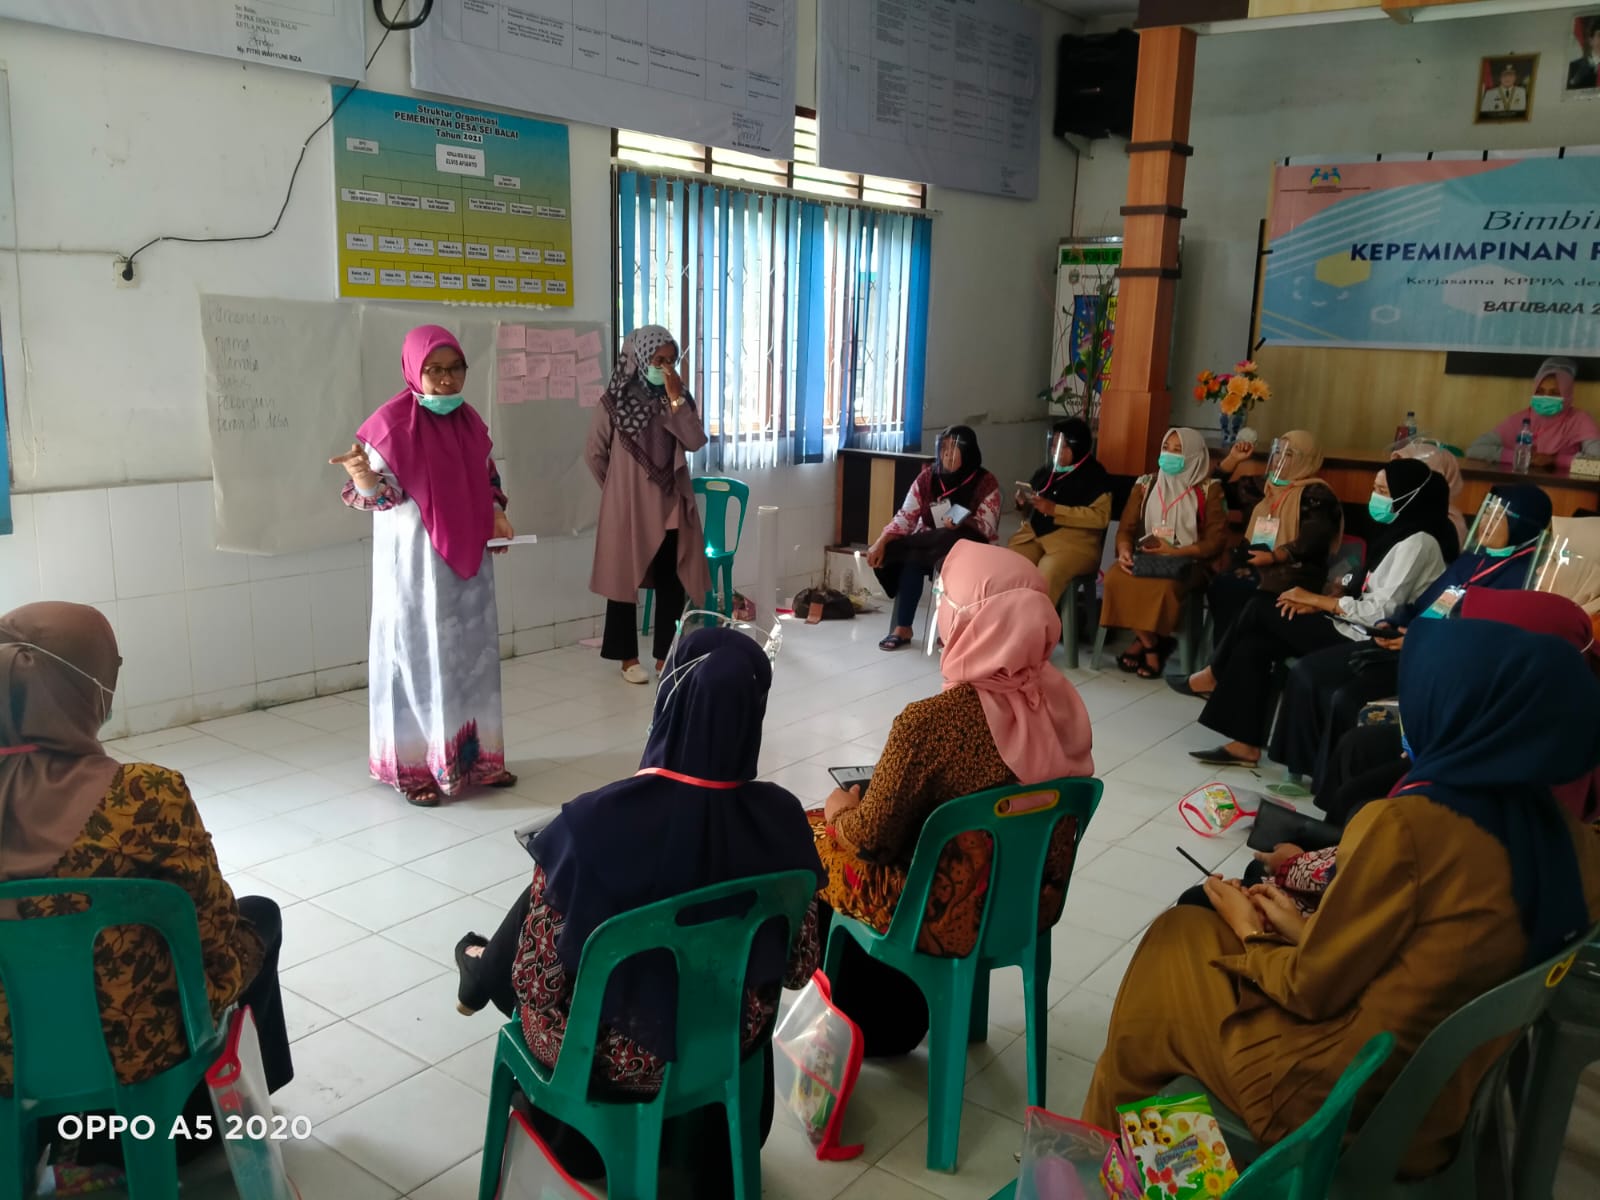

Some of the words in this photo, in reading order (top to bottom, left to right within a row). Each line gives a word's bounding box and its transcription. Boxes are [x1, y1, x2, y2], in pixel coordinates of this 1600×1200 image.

[416, 104, 452, 118] Struktur
[455, 111, 498, 126] Organisasi
[394, 111, 452, 128] PEMERINTAH
[455, 122, 477, 132] DESA
[479, 126, 493, 135] SEI
[495, 128, 518, 139] BALAI
[435, 129, 461, 140] Tahun
[463, 133, 482, 143] 2021
[1350, 241, 1578, 262] KEPEMIMPINAN
[1406, 276, 1495, 288] Kerjasama
[1503, 276, 1565, 287] KPPPA
[1483, 300, 1584, 315] BATUBARA
